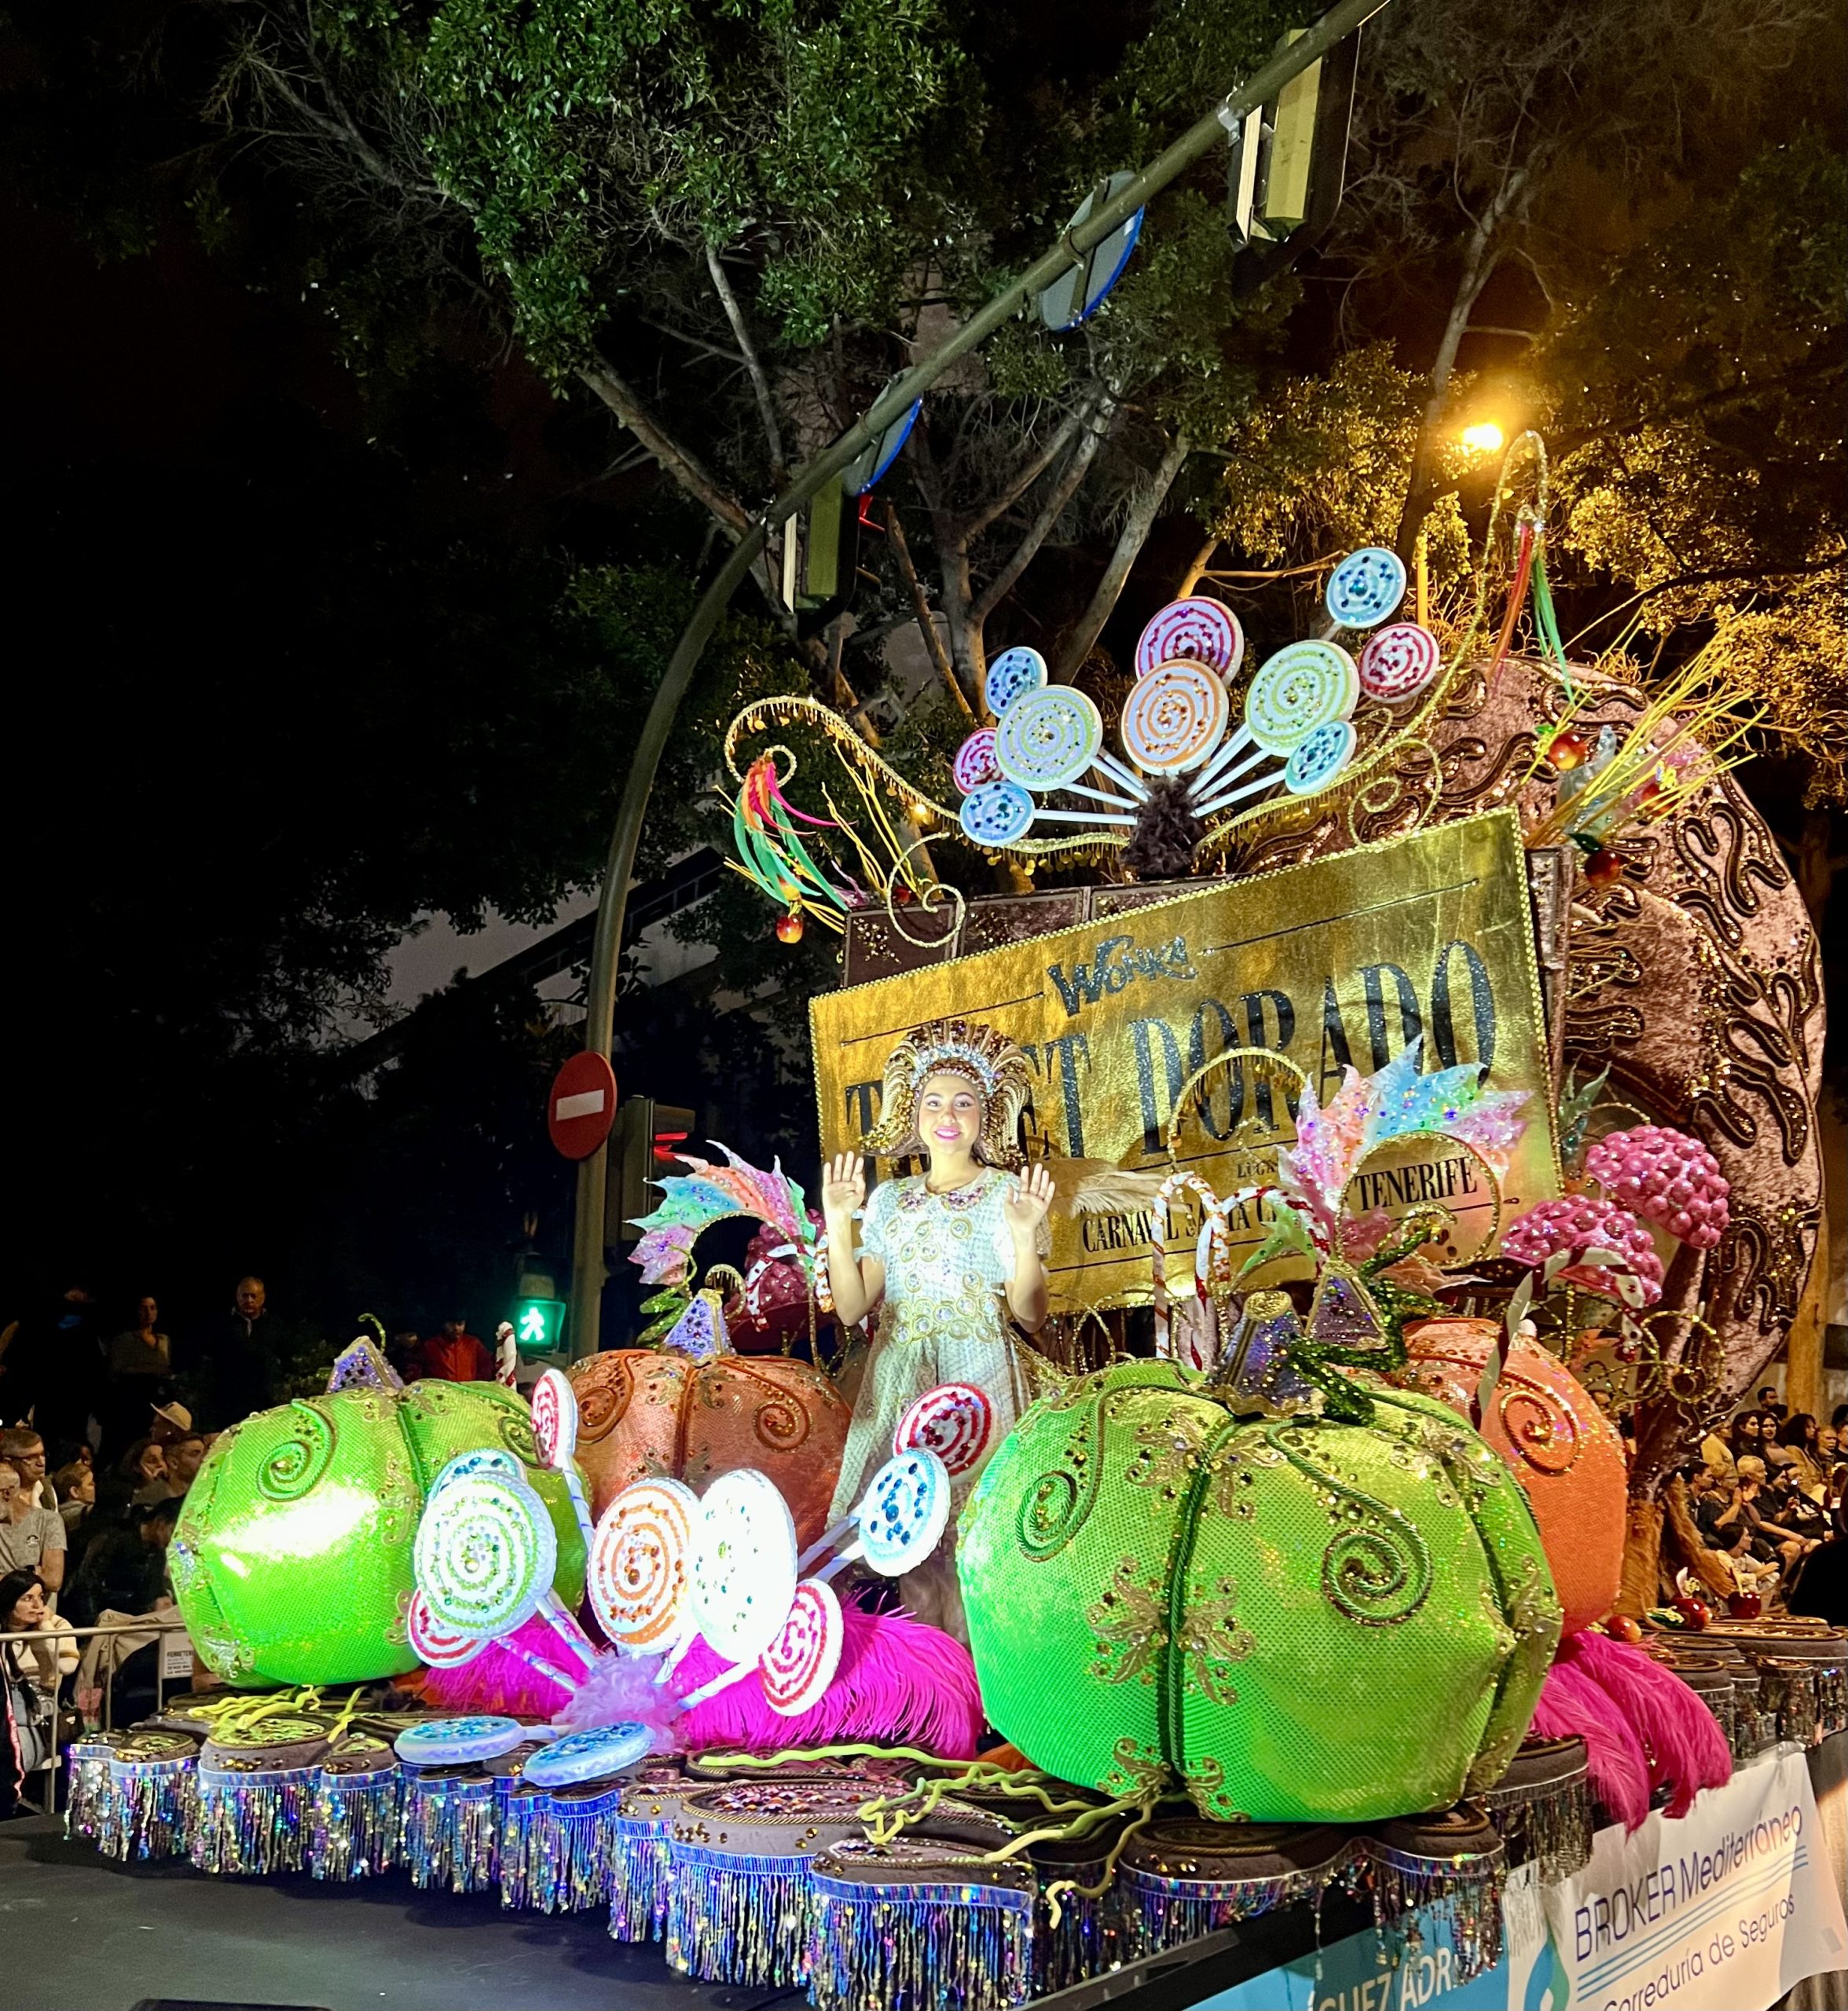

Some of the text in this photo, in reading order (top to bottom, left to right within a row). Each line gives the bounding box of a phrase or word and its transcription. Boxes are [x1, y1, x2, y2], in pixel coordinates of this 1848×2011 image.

[1128, 939, 1496, 1157] DORADO
[1082, 1204, 1179, 1253] CARNAVL
[1354, 1156, 1478, 1211] TENERIFE
[1575, 1864, 1677, 1963] BROKER
[1708, 1932, 1736, 1965] de
[1738, 1893, 1795, 1950] Seguros
